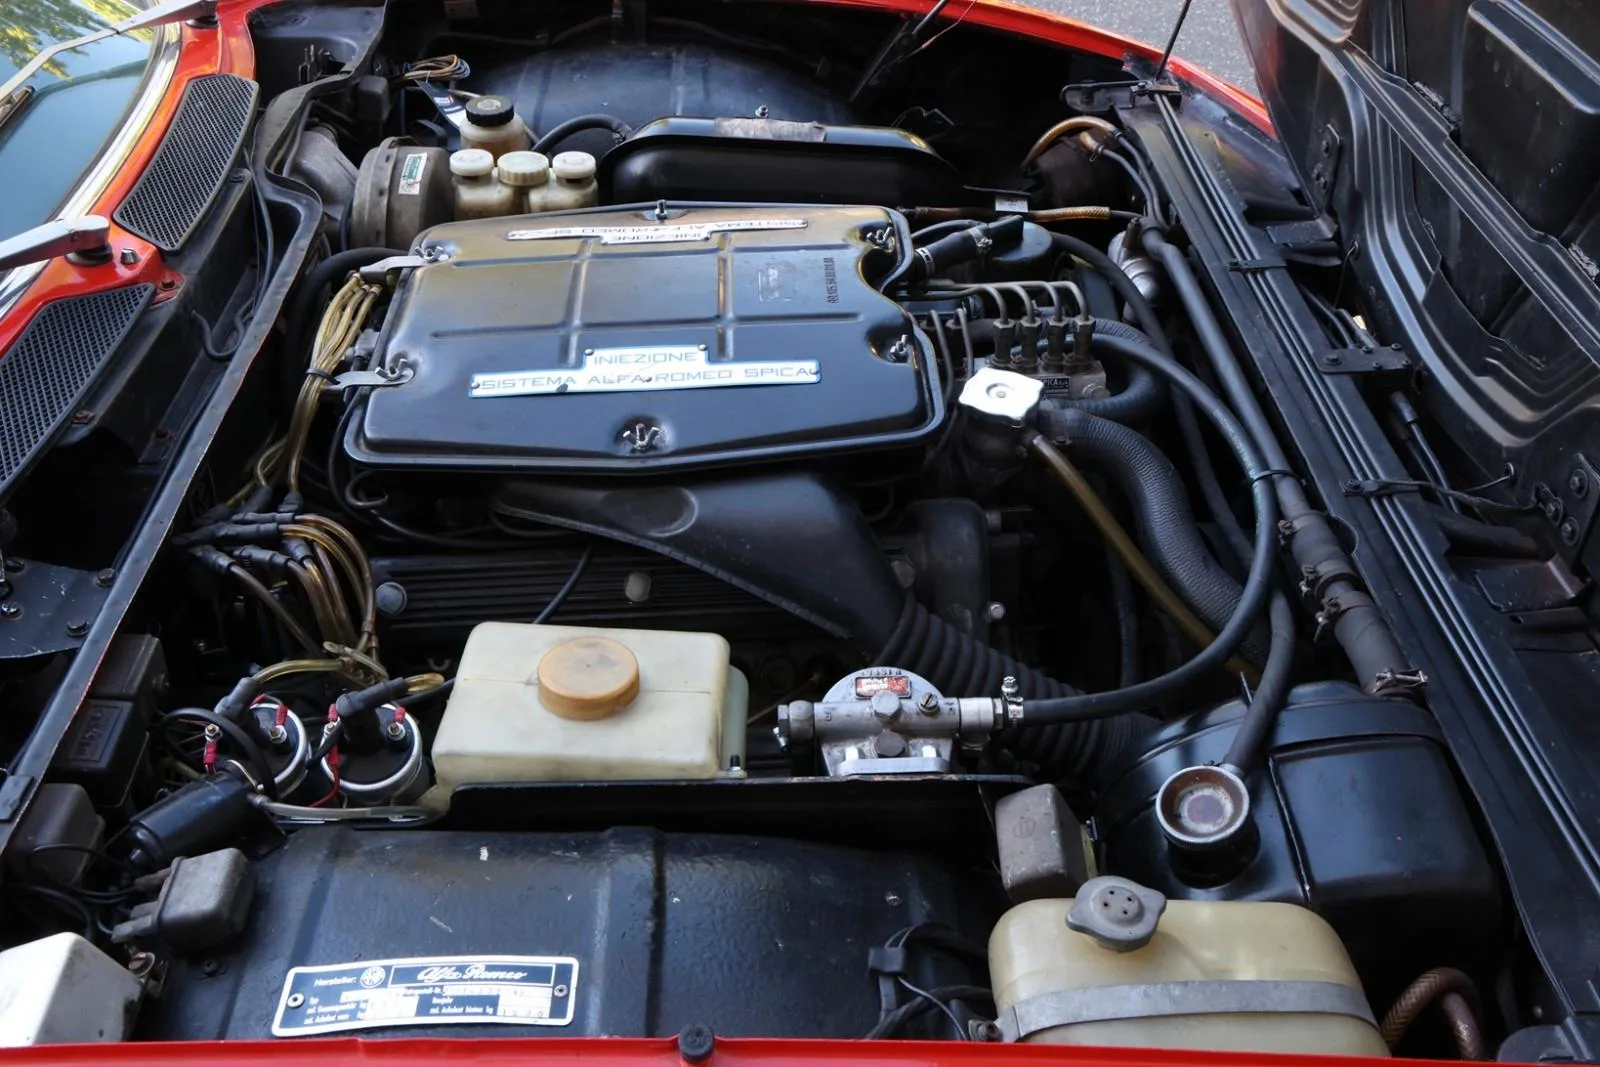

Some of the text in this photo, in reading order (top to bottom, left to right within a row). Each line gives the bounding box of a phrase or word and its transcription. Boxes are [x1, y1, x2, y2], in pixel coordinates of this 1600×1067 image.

[593, 351, 698, 365] INIEZIONE
[480, 366, 809, 390] SISTEMA ALFA ROMEO SPICA
[416, 963, 527, 983] Alfa Romeo
